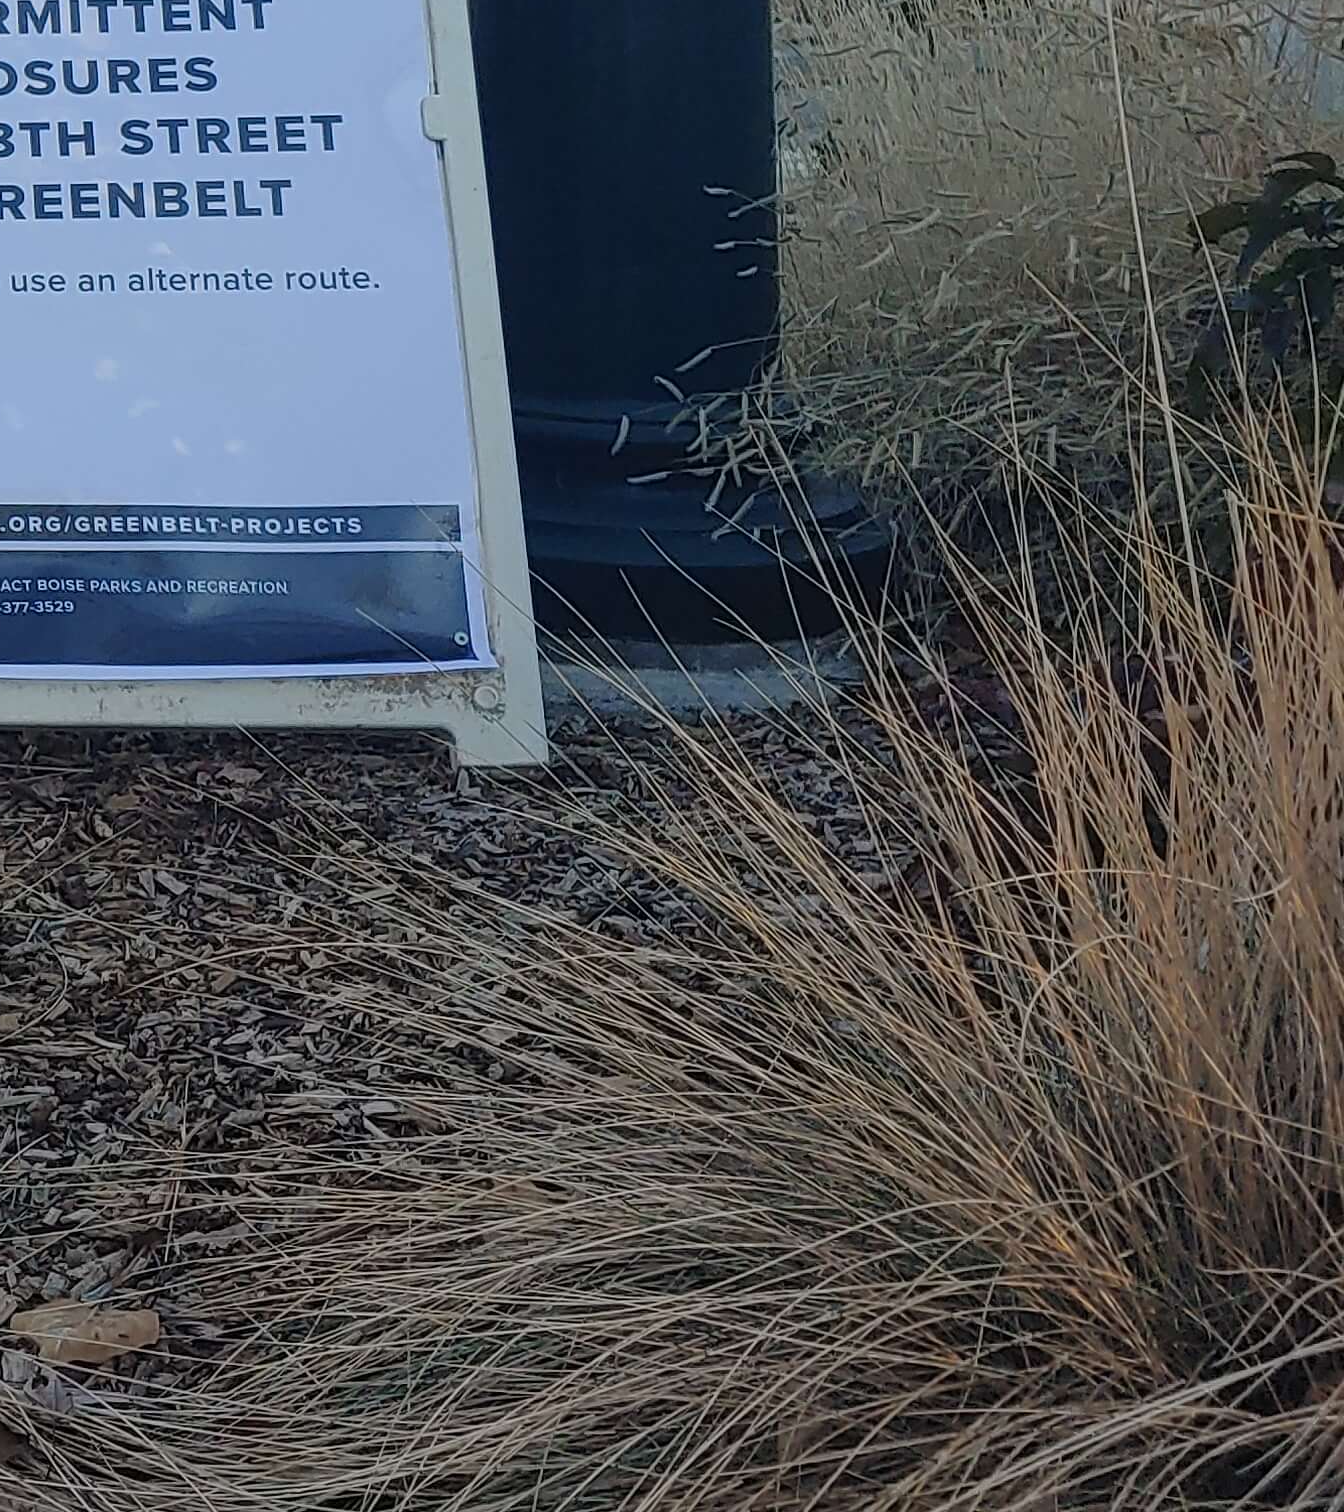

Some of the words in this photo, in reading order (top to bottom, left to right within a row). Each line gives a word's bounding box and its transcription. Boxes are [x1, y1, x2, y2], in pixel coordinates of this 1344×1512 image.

[121, 115, 342, 154] STREET
[11, 273, 67, 292] use
[78, 272, 116, 291] an
[128, 267, 273, 291] alternate
[284, 270, 381, 290] route.
[38, 580, 85, 591] BOISE
[91, 580, 141, 593] PARKS
[146, 581, 181, 593] AND
[187, 580, 288, 594] RECREATION
